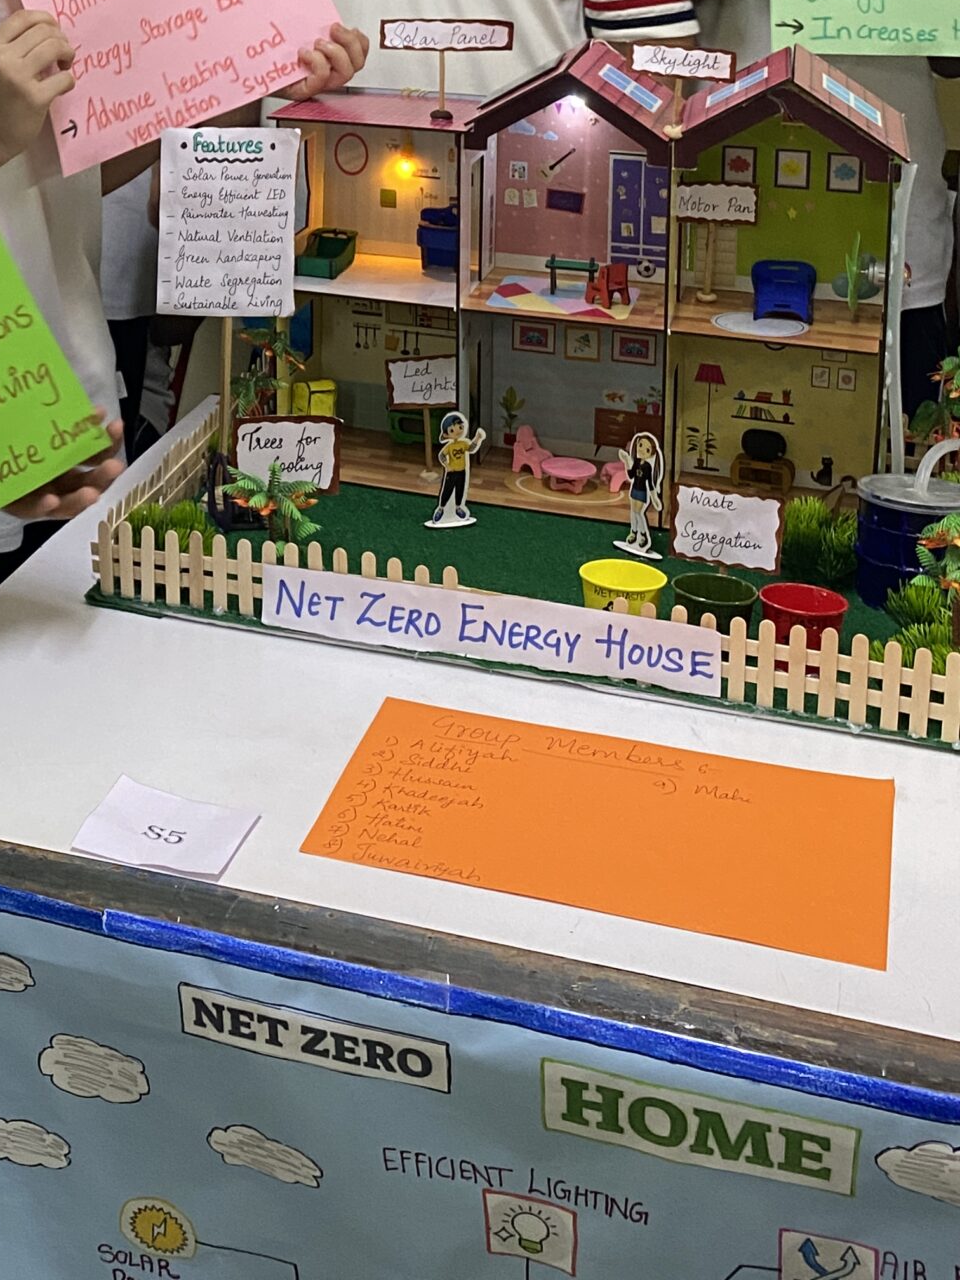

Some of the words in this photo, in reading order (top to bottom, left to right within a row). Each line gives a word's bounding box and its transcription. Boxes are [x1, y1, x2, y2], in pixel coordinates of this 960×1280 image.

[388, 26, 440, 49] Solar
[448, 26, 499, 46] Panel
[811, 16, 937, 44] Increases
[71, 39, 133, 82] Energy
[139, 6, 209, 46] Storage
[85, 90, 156, 135] Advance
[162, 56, 241, 97] heating
[246, 21, 286, 60] and
[192, 131, 263, 154] Features
[181, 167, 217, 181] Solar
[220, 166, 250, 182] Power
[181, 186, 213, 208] Energy
[218, 187, 261, 204] Efficient
[265, 188, 286, 200] LED
[678, 194, 719, 213] Motor
[180, 207, 235, 225] Rainwater
[238, 205, 289, 230] Harvesting
[177, 230, 222, 243] Natural
[227, 229, 284, 244] Ventilation
[174, 246, 210, 271] Green
[175, 274, 212, 289] Waste
[220, 271, 282, 295] Segregation
[173, 292, 239, 310] Sustainable
[247, 294, 284, 316] Living
[403, 361, 432, 378] Led
[241, 426, 284, 452] Trees
[295, 426, 321, 461] for
[273, 456, 323, 486] ooling
[689, 490, 738, 512] Waste
[681, 522, 764, 561] Segregation
[356, 591, 442, 638] ZERO
[458, 603, 581, 664] ENERGY
[594, 623, 716, 680] HOUSE
[385, 736, 399, 747] 1)
[431, 714, 521, 749] Group
[372, 749, 395, 762] 2)
[363, 762, 383, 777] 3)
[356, 778, 377, 793] 4)
[337, 806, 357, 824] 6)
[345, 791, 368, 807] 5)
[372, 798, 433, 817] Kartik
[140, 824, 188, 845] S5
[322, 838, 344, 854] 8)
[358, 828, 424, 849] Nehal
[191, 996, 291, 1056] NET
[300, 1025, 434, 1080] ZERO
[555, 1074, 833, 1182] HOME
[381, 1146, 515, 1191] EFFICIENT
[529, 1170, 651, 1228] LIGHTING
[97, 1243, 181, 1280] SOLAR
[880, 1250, 928, 1280] AIR
